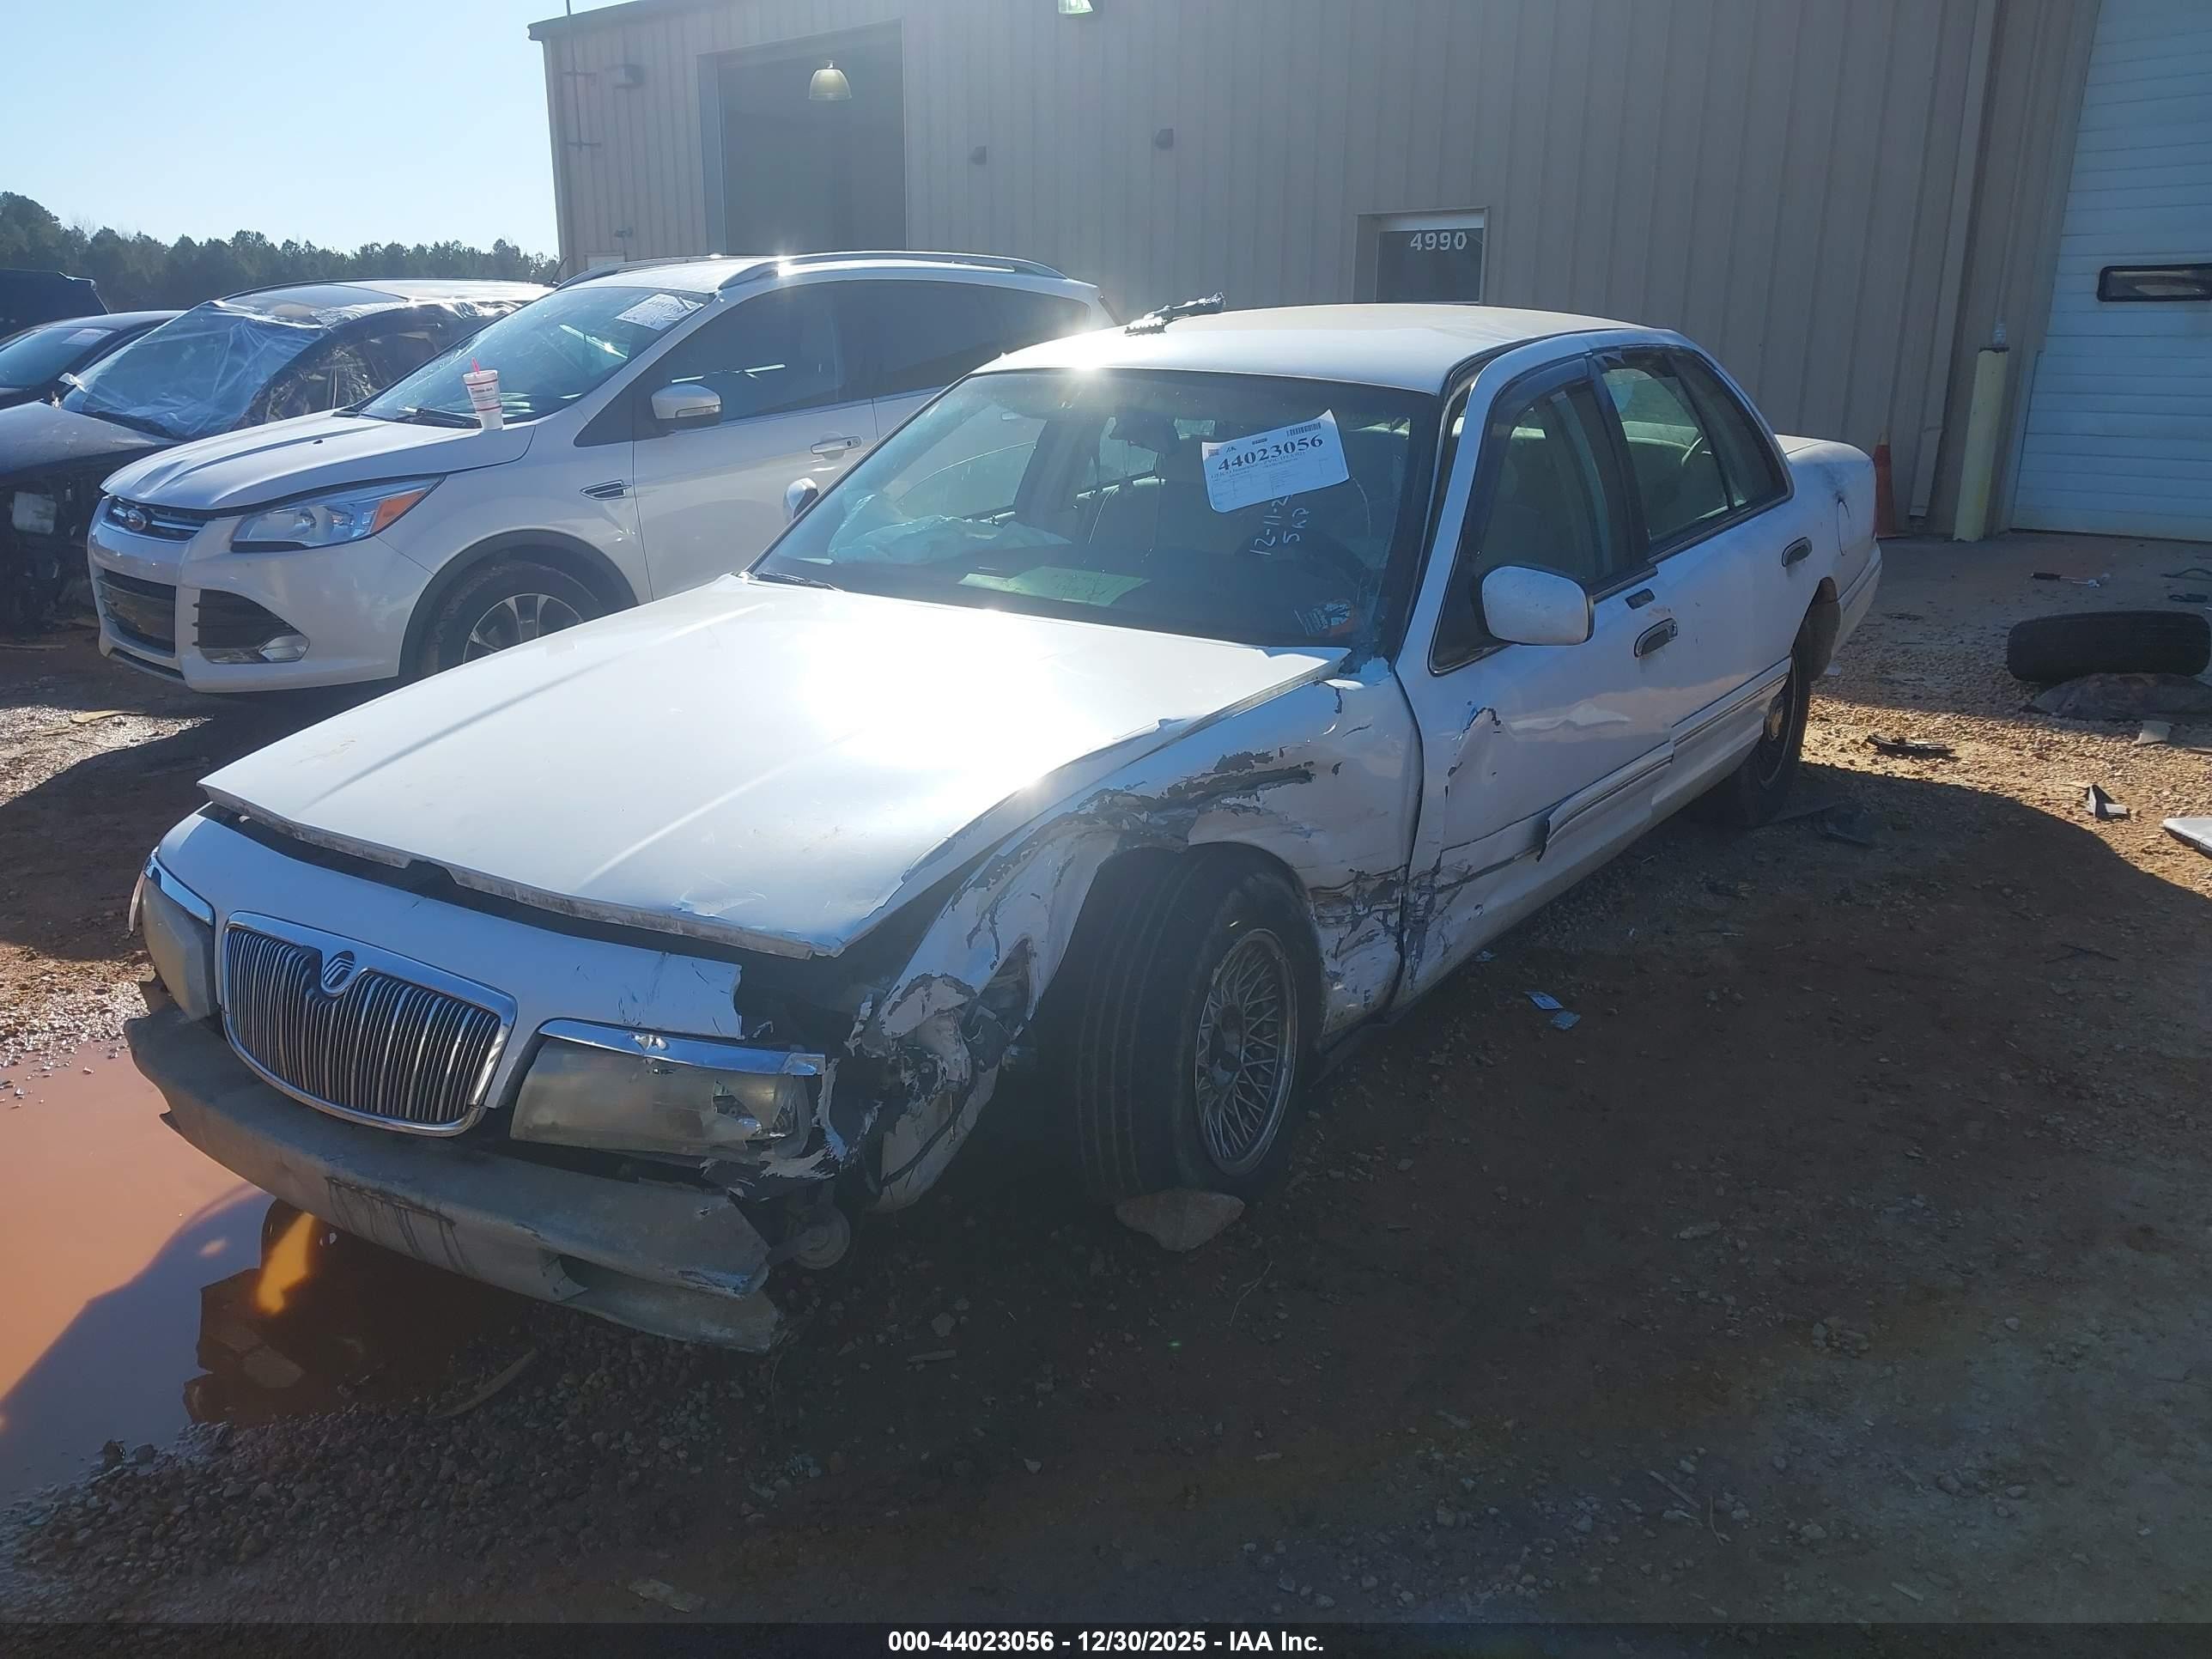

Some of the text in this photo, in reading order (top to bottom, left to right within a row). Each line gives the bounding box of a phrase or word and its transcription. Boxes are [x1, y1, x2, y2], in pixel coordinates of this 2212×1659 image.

[1410, 231, 1468, 251] 4990
[1218, 433, 1323, 471] 44023056
[1249, 495, 1292, 556] 12-11-2
